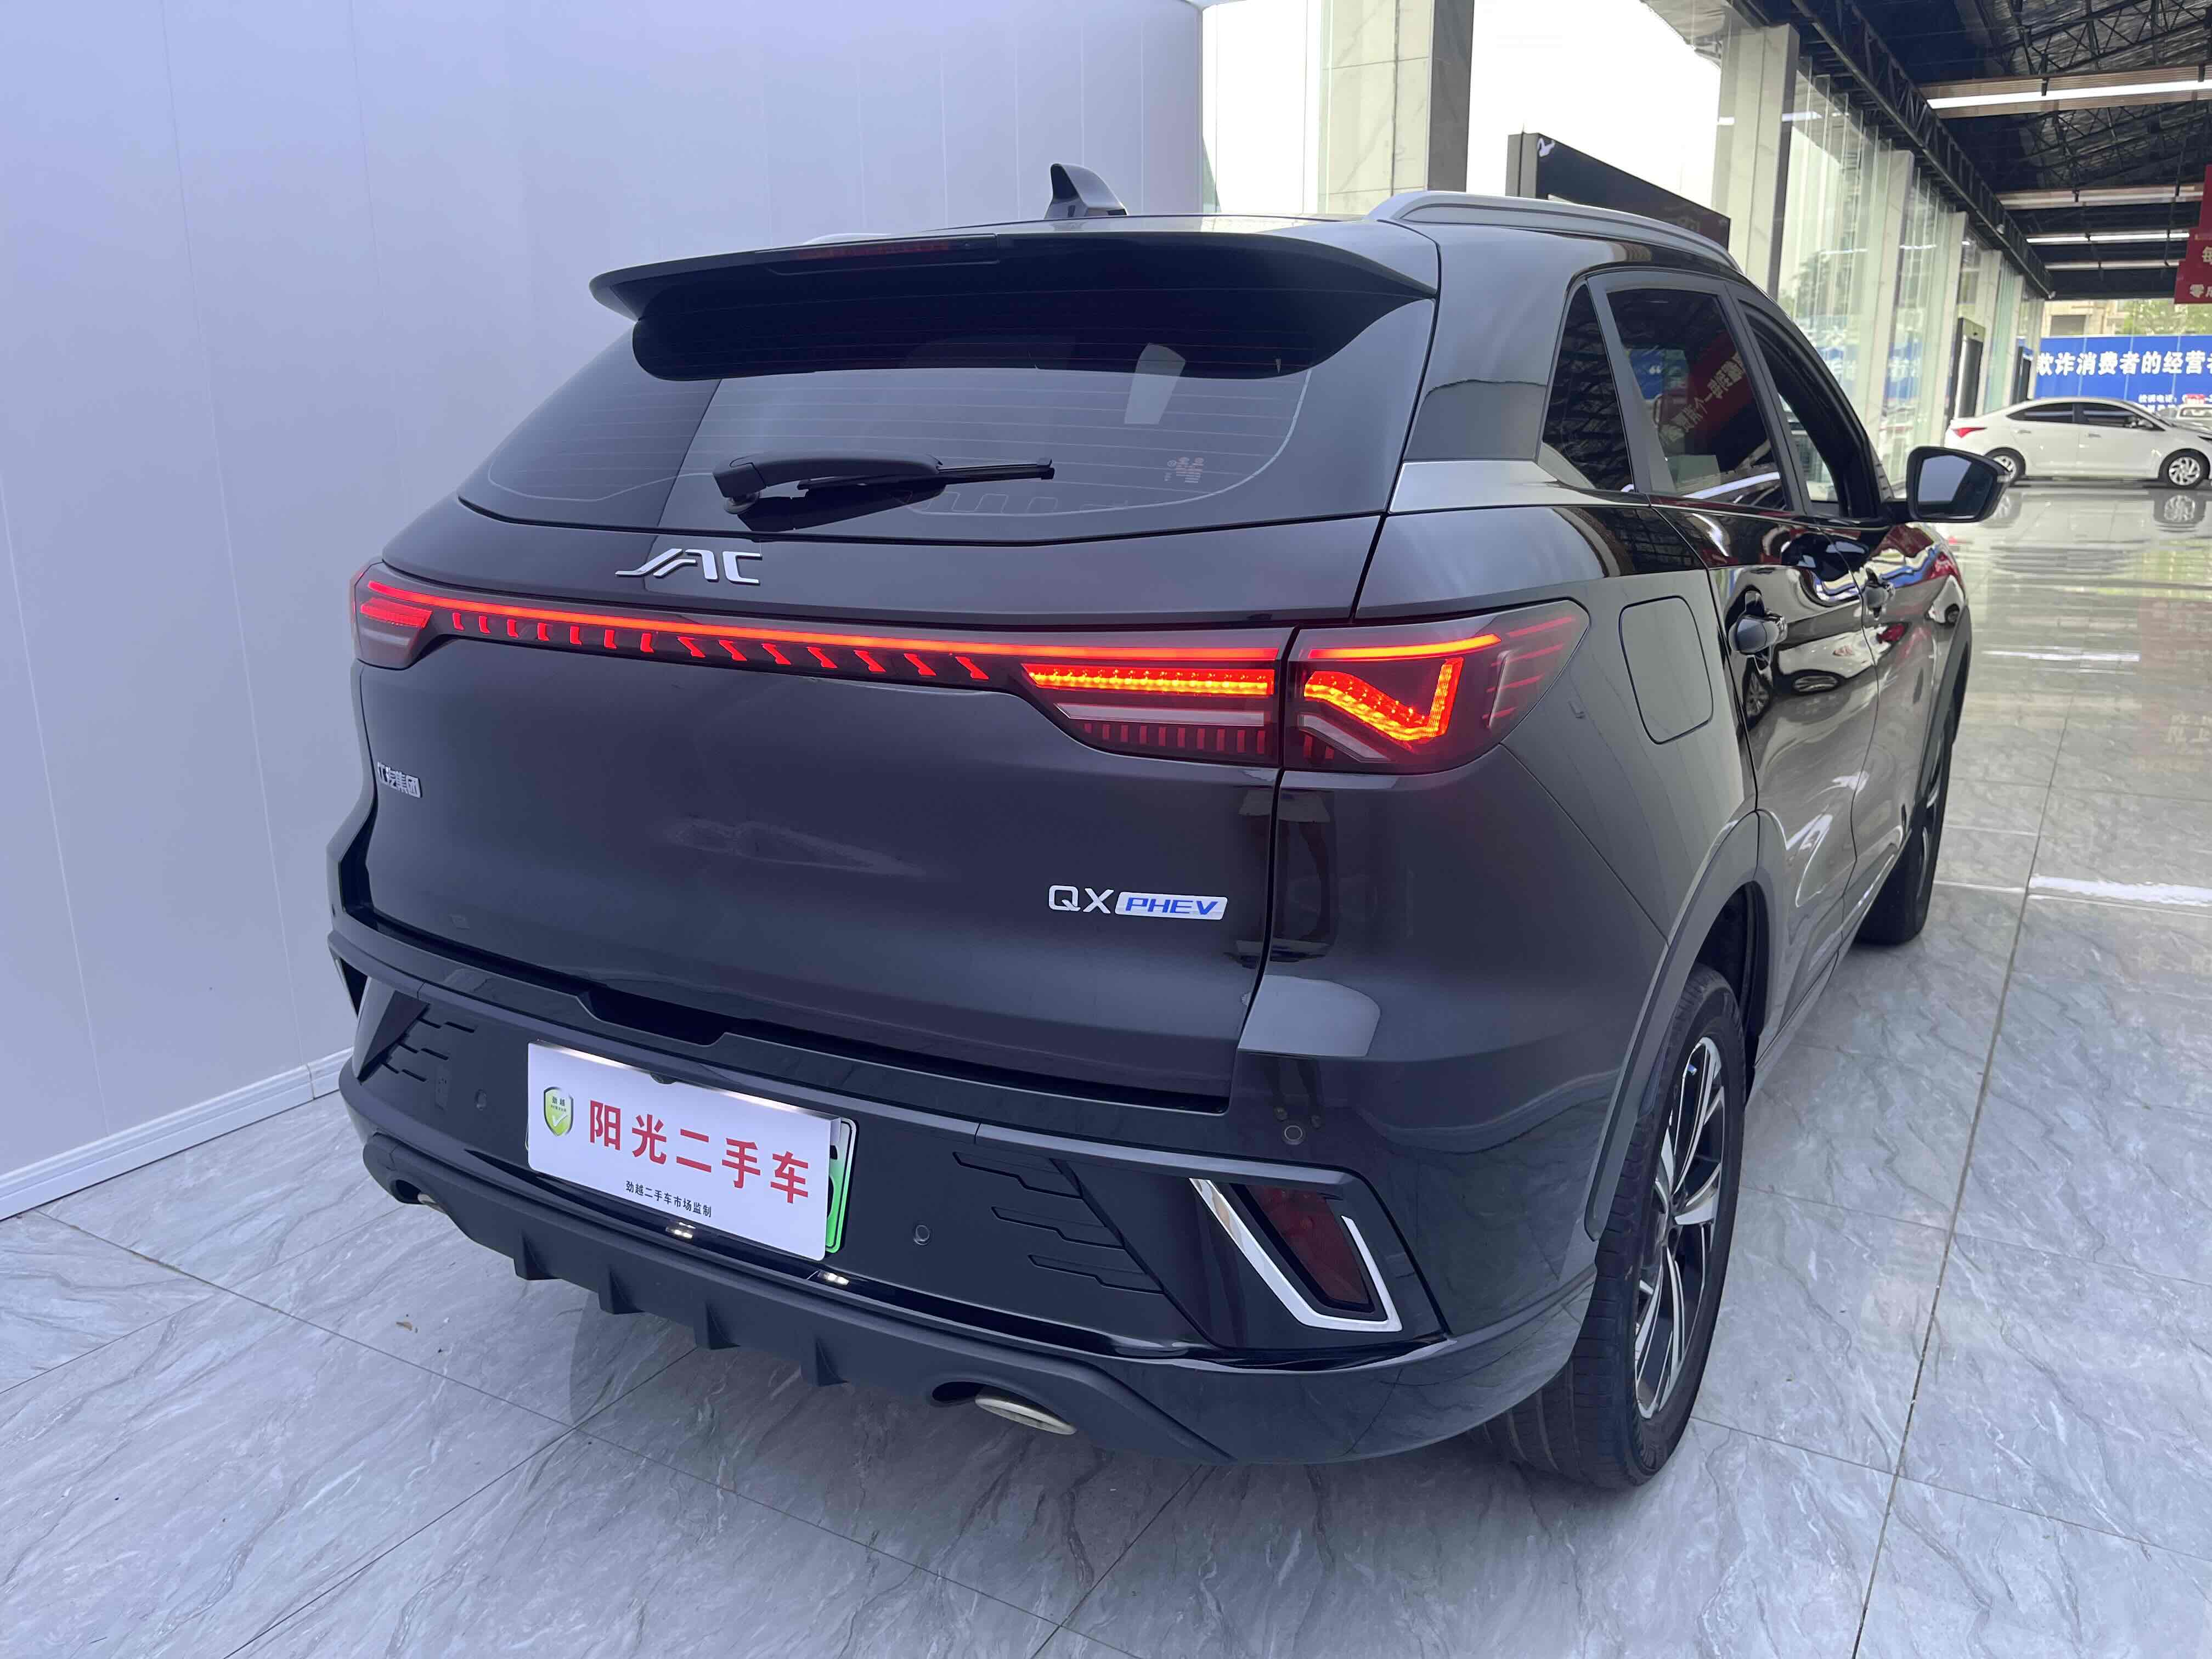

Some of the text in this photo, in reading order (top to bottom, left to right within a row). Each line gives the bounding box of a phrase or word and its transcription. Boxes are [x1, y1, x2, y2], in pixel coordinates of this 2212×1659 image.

[2036, 351, 2212, 376] 欺诈消费者的经营
[1048, 885, 1218, 915] QX PHEV
[589, 1099, 809, 1204] 阳光二手车
[625, 1180, 712, 1218] 劲越二手车市场监制
